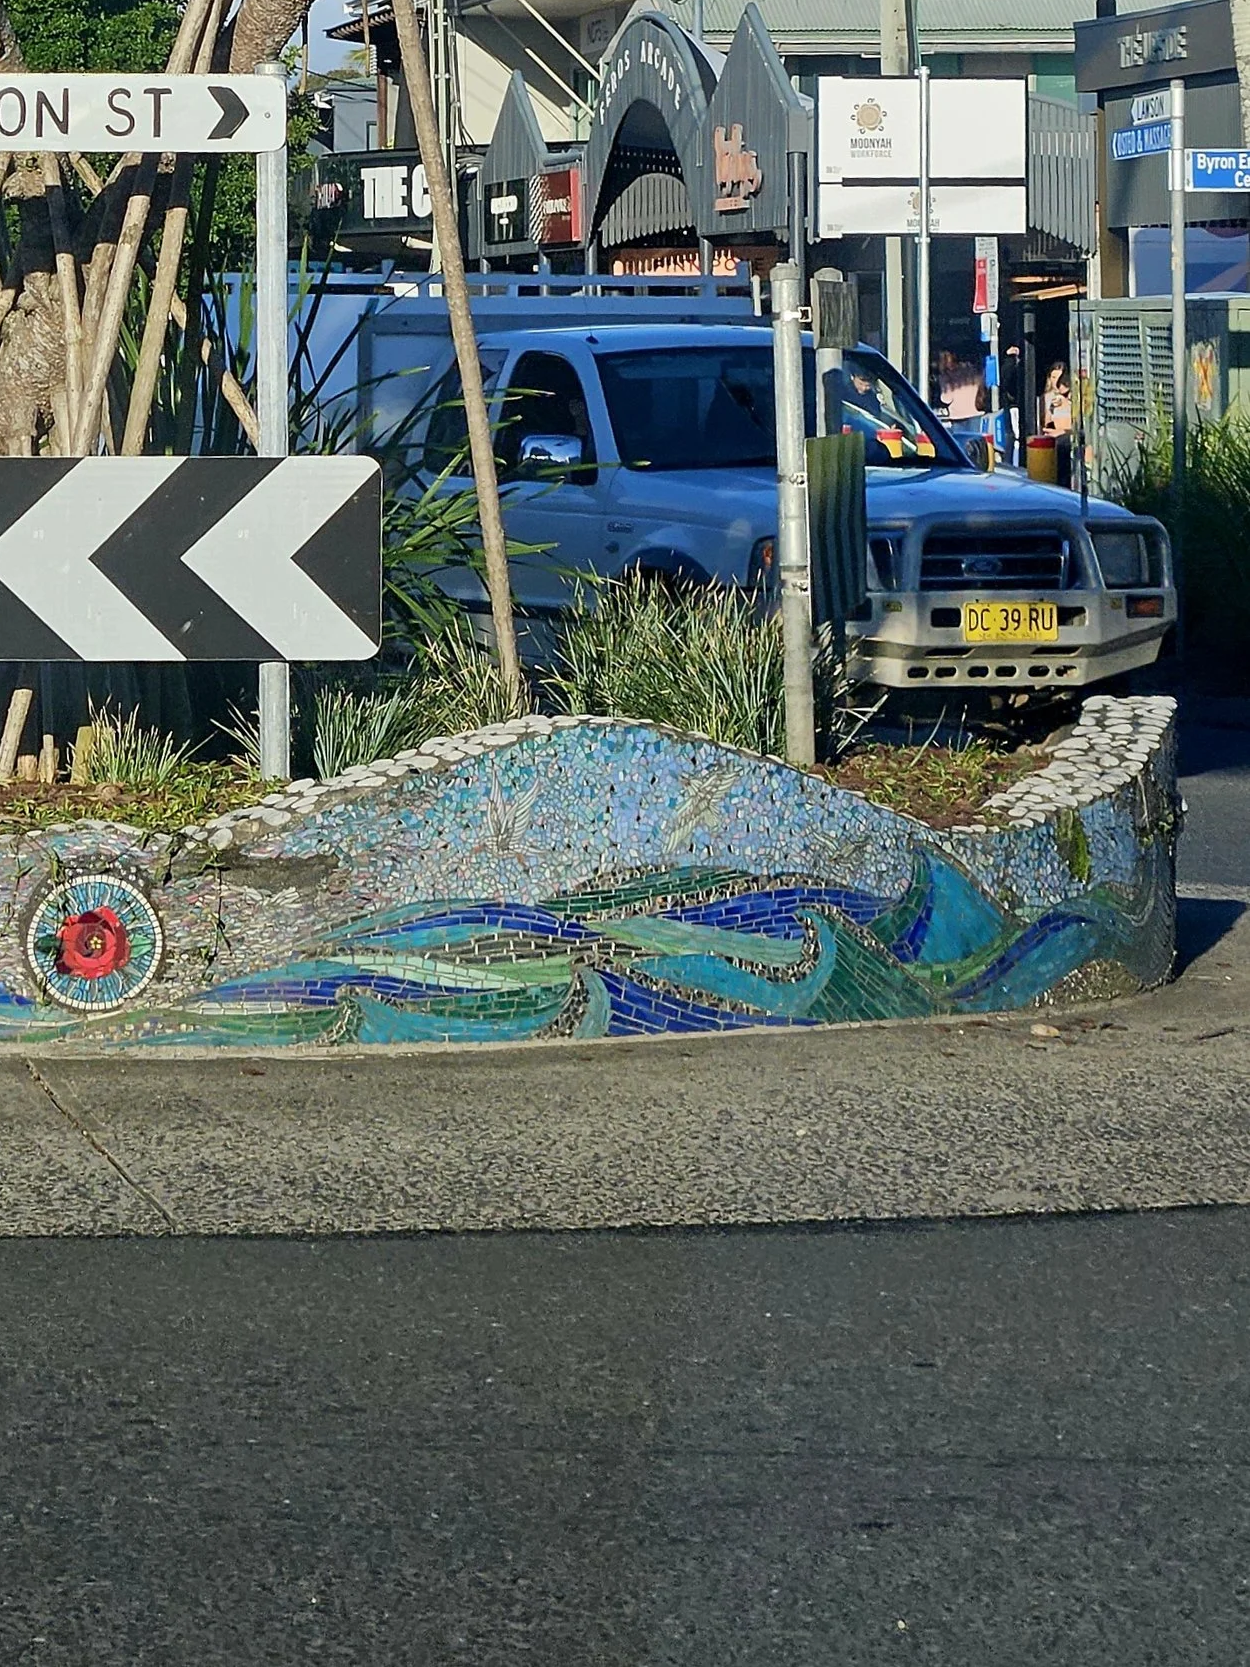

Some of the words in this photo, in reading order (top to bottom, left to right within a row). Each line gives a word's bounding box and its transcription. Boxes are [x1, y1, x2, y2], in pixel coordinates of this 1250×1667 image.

[599, 49, 630, 125] FEROS
[640, 40, 681, 110] ARCADE
[105, 88, 172, 138] ST
[1136, 95, 1165, 122] LAWSON
[850, 138, 892, 149] MOONYAH
[850, 150, 892, 159] WORKFORCE
[1117, 131, 1136, 155] OSTEO
[1137, 129, 1143, 152] &
[1197, 153, 1236, 175] Byron
[361, 166, 408, 219] THE
